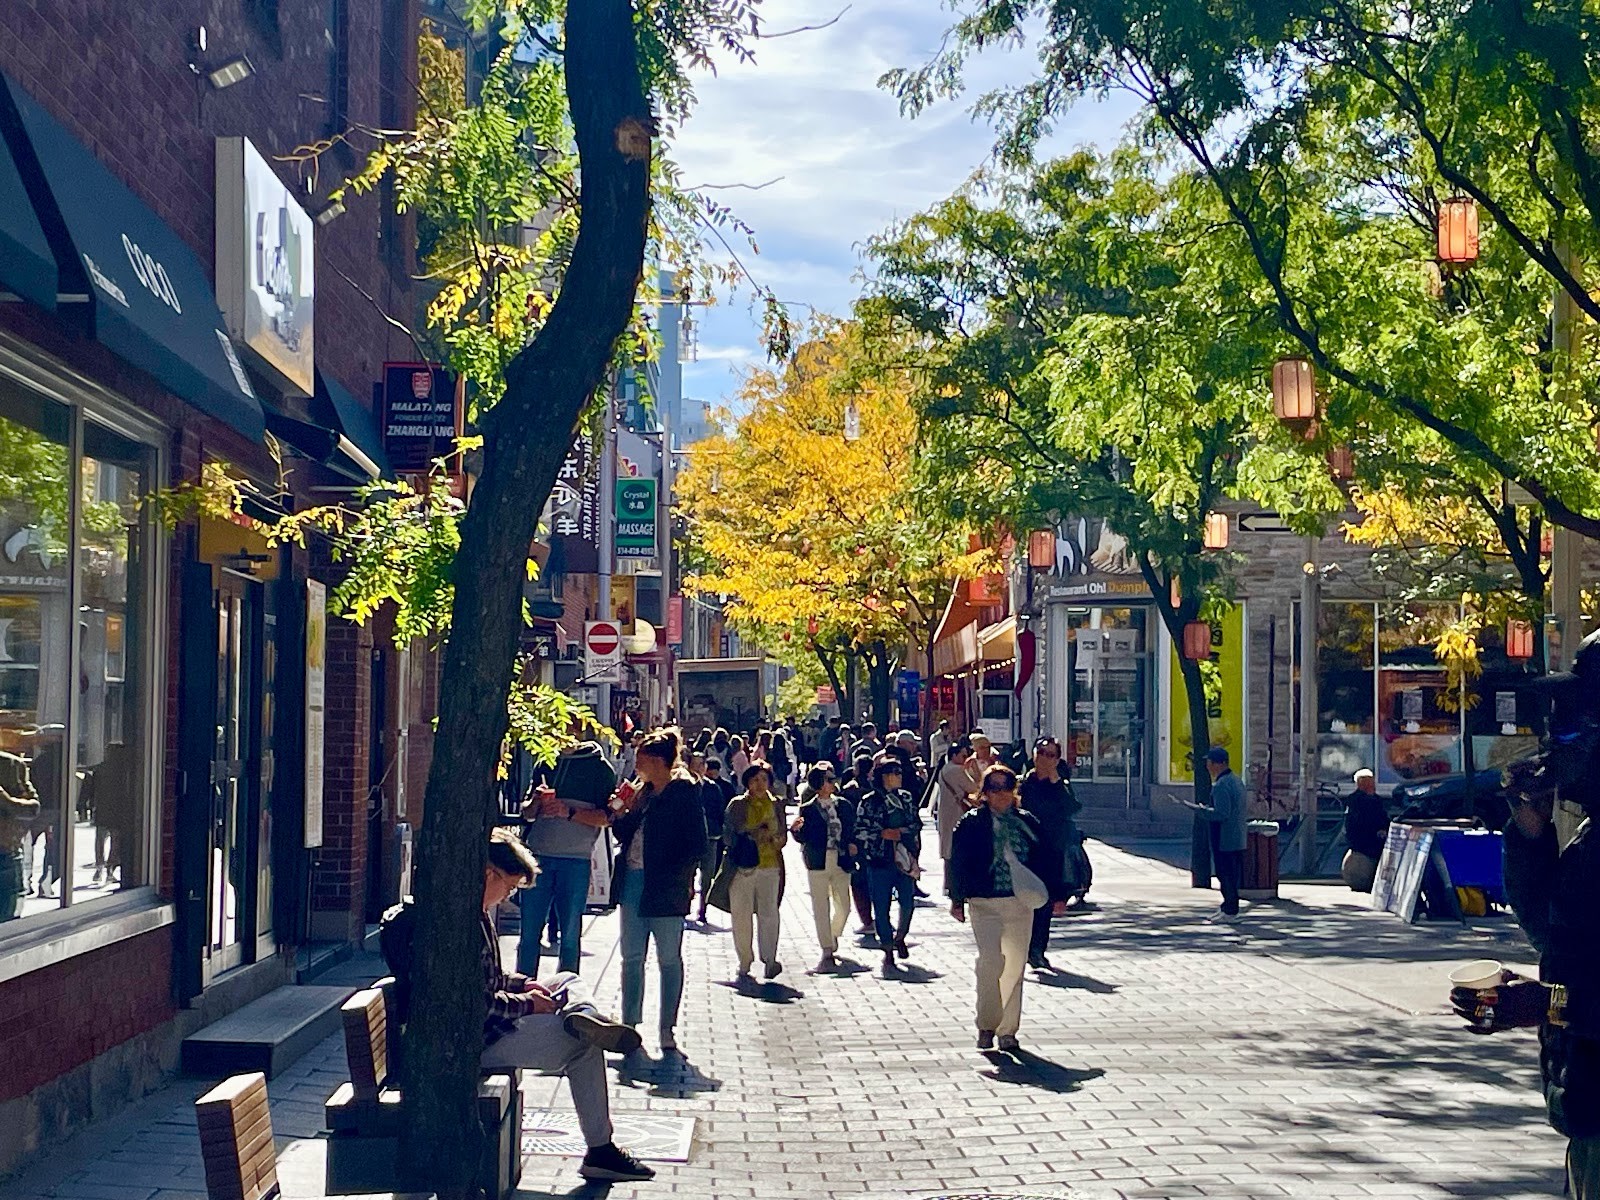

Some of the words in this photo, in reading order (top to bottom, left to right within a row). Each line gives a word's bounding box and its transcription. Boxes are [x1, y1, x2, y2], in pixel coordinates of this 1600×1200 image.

[623, 490, 650, 500] Crystal
[628, 501, 645, 510] 水晶
[618, 523, 654, 536] MASSAGE
[1089, 582, 1107, 594] Oh!
[1075, 756, 1092, 767] 514
